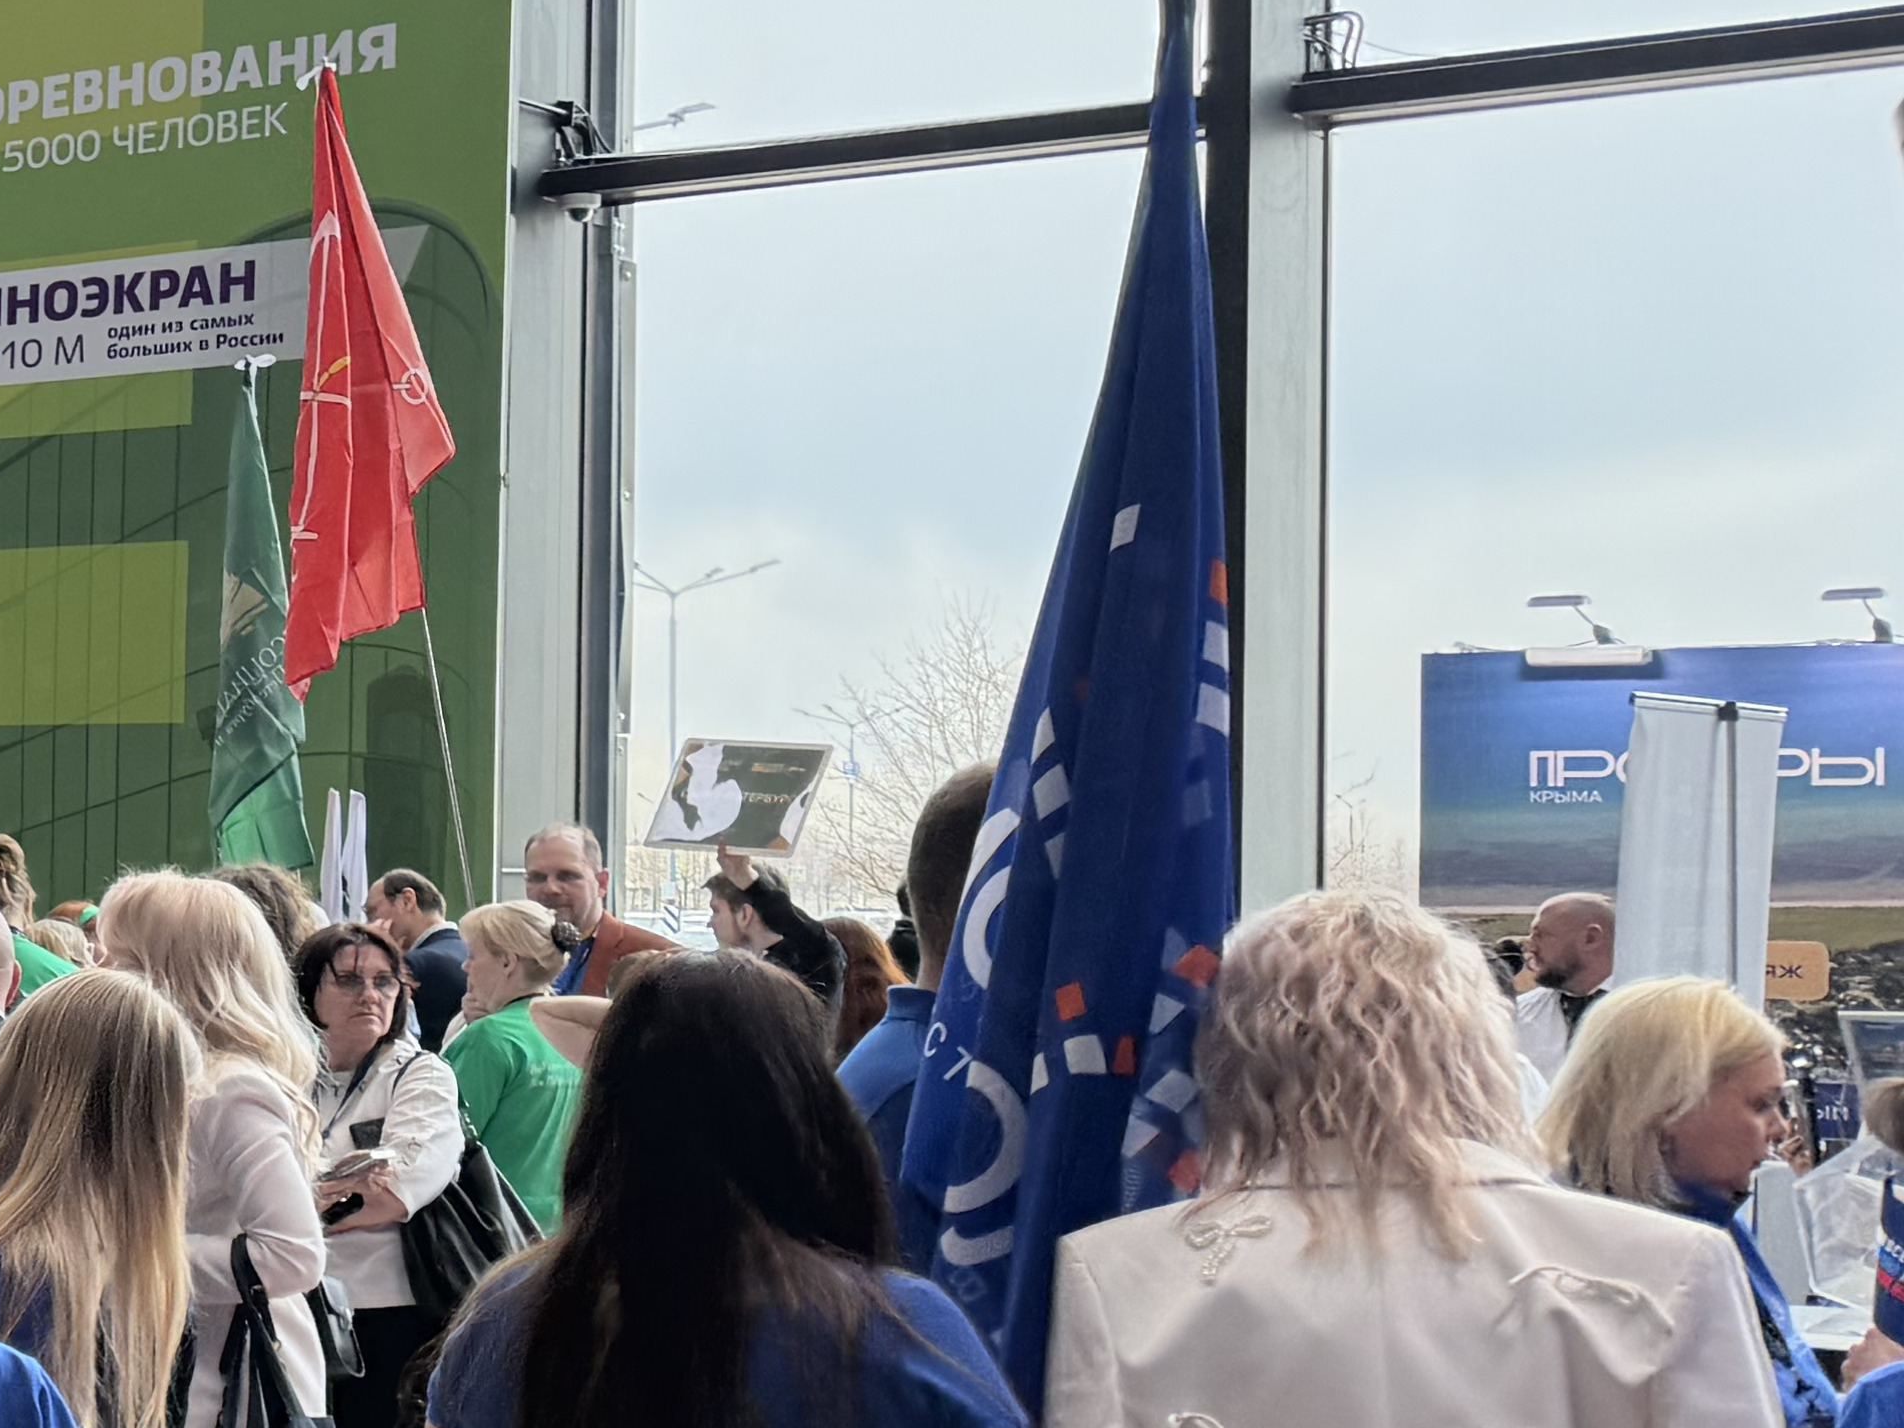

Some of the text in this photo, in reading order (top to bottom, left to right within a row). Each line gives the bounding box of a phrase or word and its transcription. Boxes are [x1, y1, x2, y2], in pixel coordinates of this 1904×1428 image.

[0, 128, 103, 175] 5000
[110, 100, 291, 162] ЧЕЛОВЕК
[107, 313, 255, 340] один из самых
[53, 334, 86, 366] М
[106, 332, 286, 360] больших в России
[1529, 789, 1604, 804] КРЫМА
